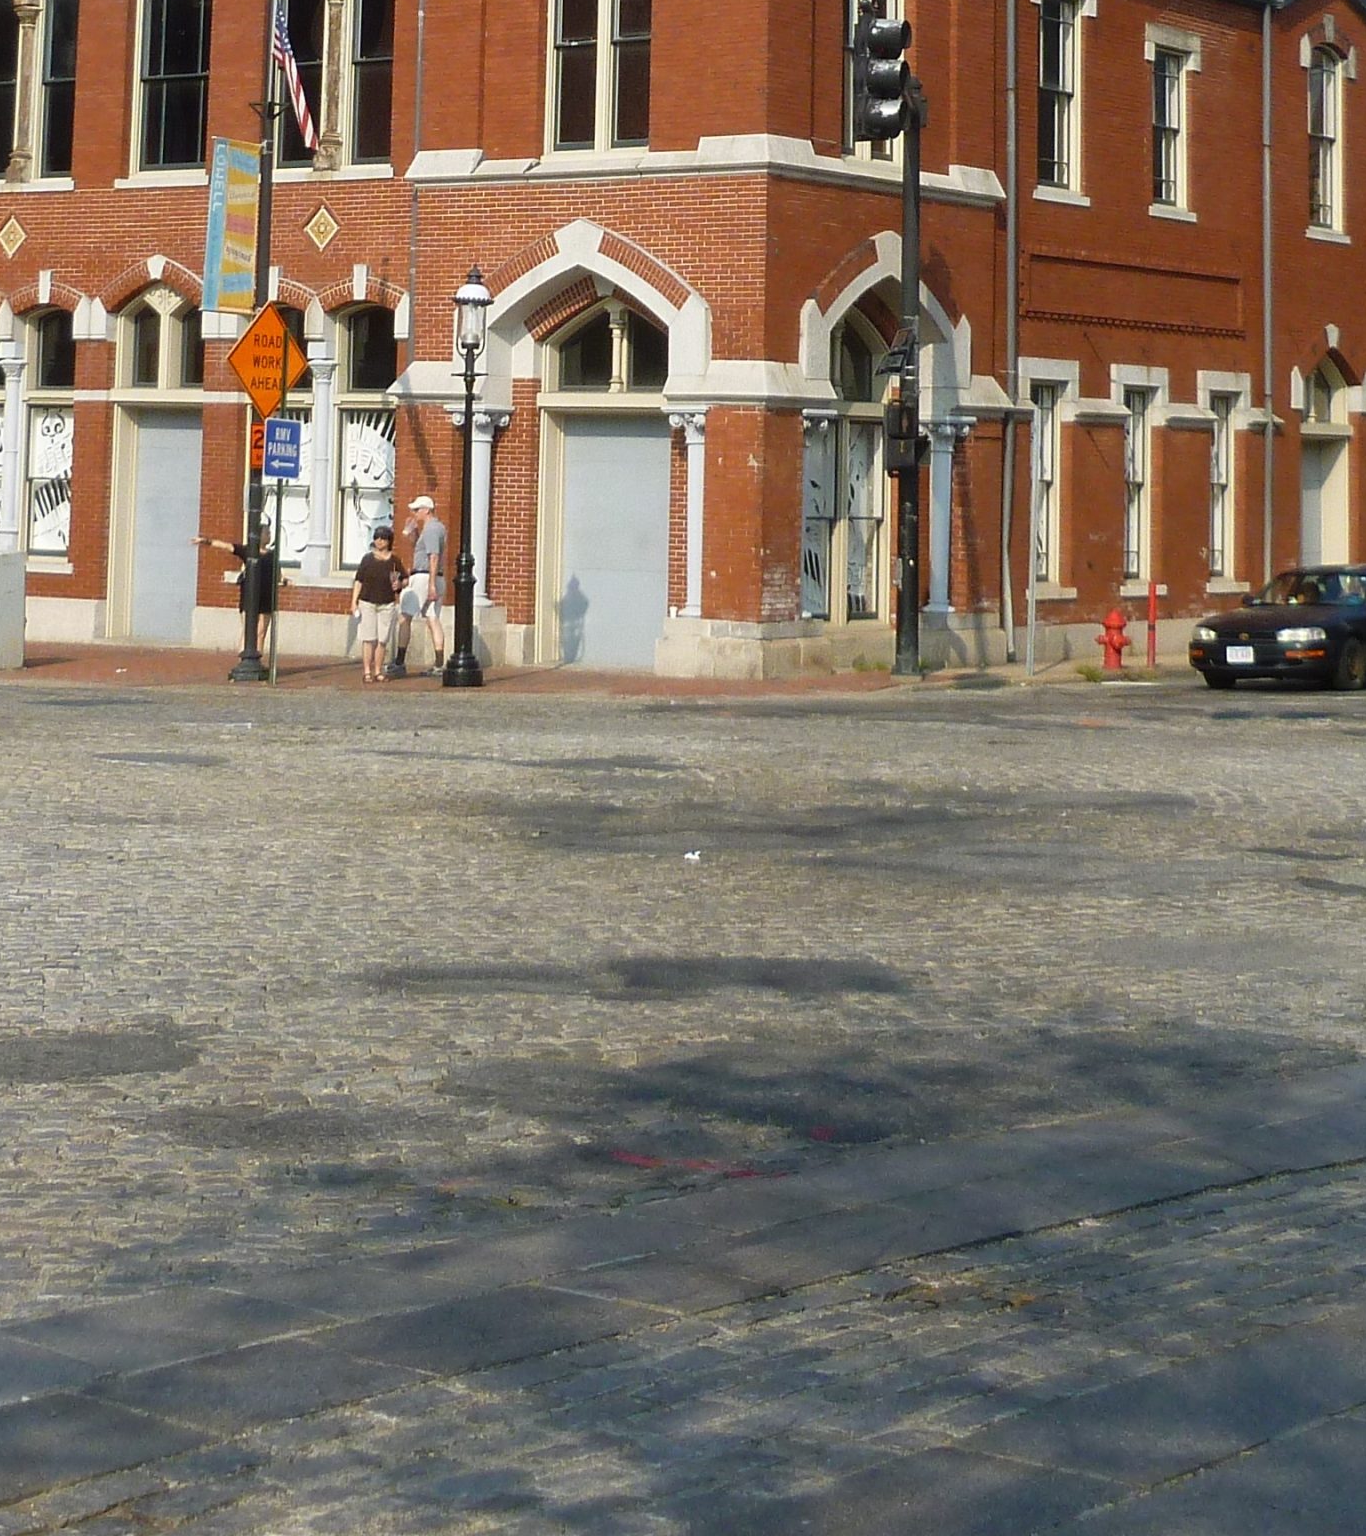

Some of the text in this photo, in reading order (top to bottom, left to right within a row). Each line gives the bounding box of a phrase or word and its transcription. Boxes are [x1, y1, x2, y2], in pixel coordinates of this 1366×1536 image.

[211, 143, 227, 212] LOWELL
[253, 334, 282, 349] ROAD
[252, 354, 282, 369] WORK
[267, 441, 298, 458] PARKING
